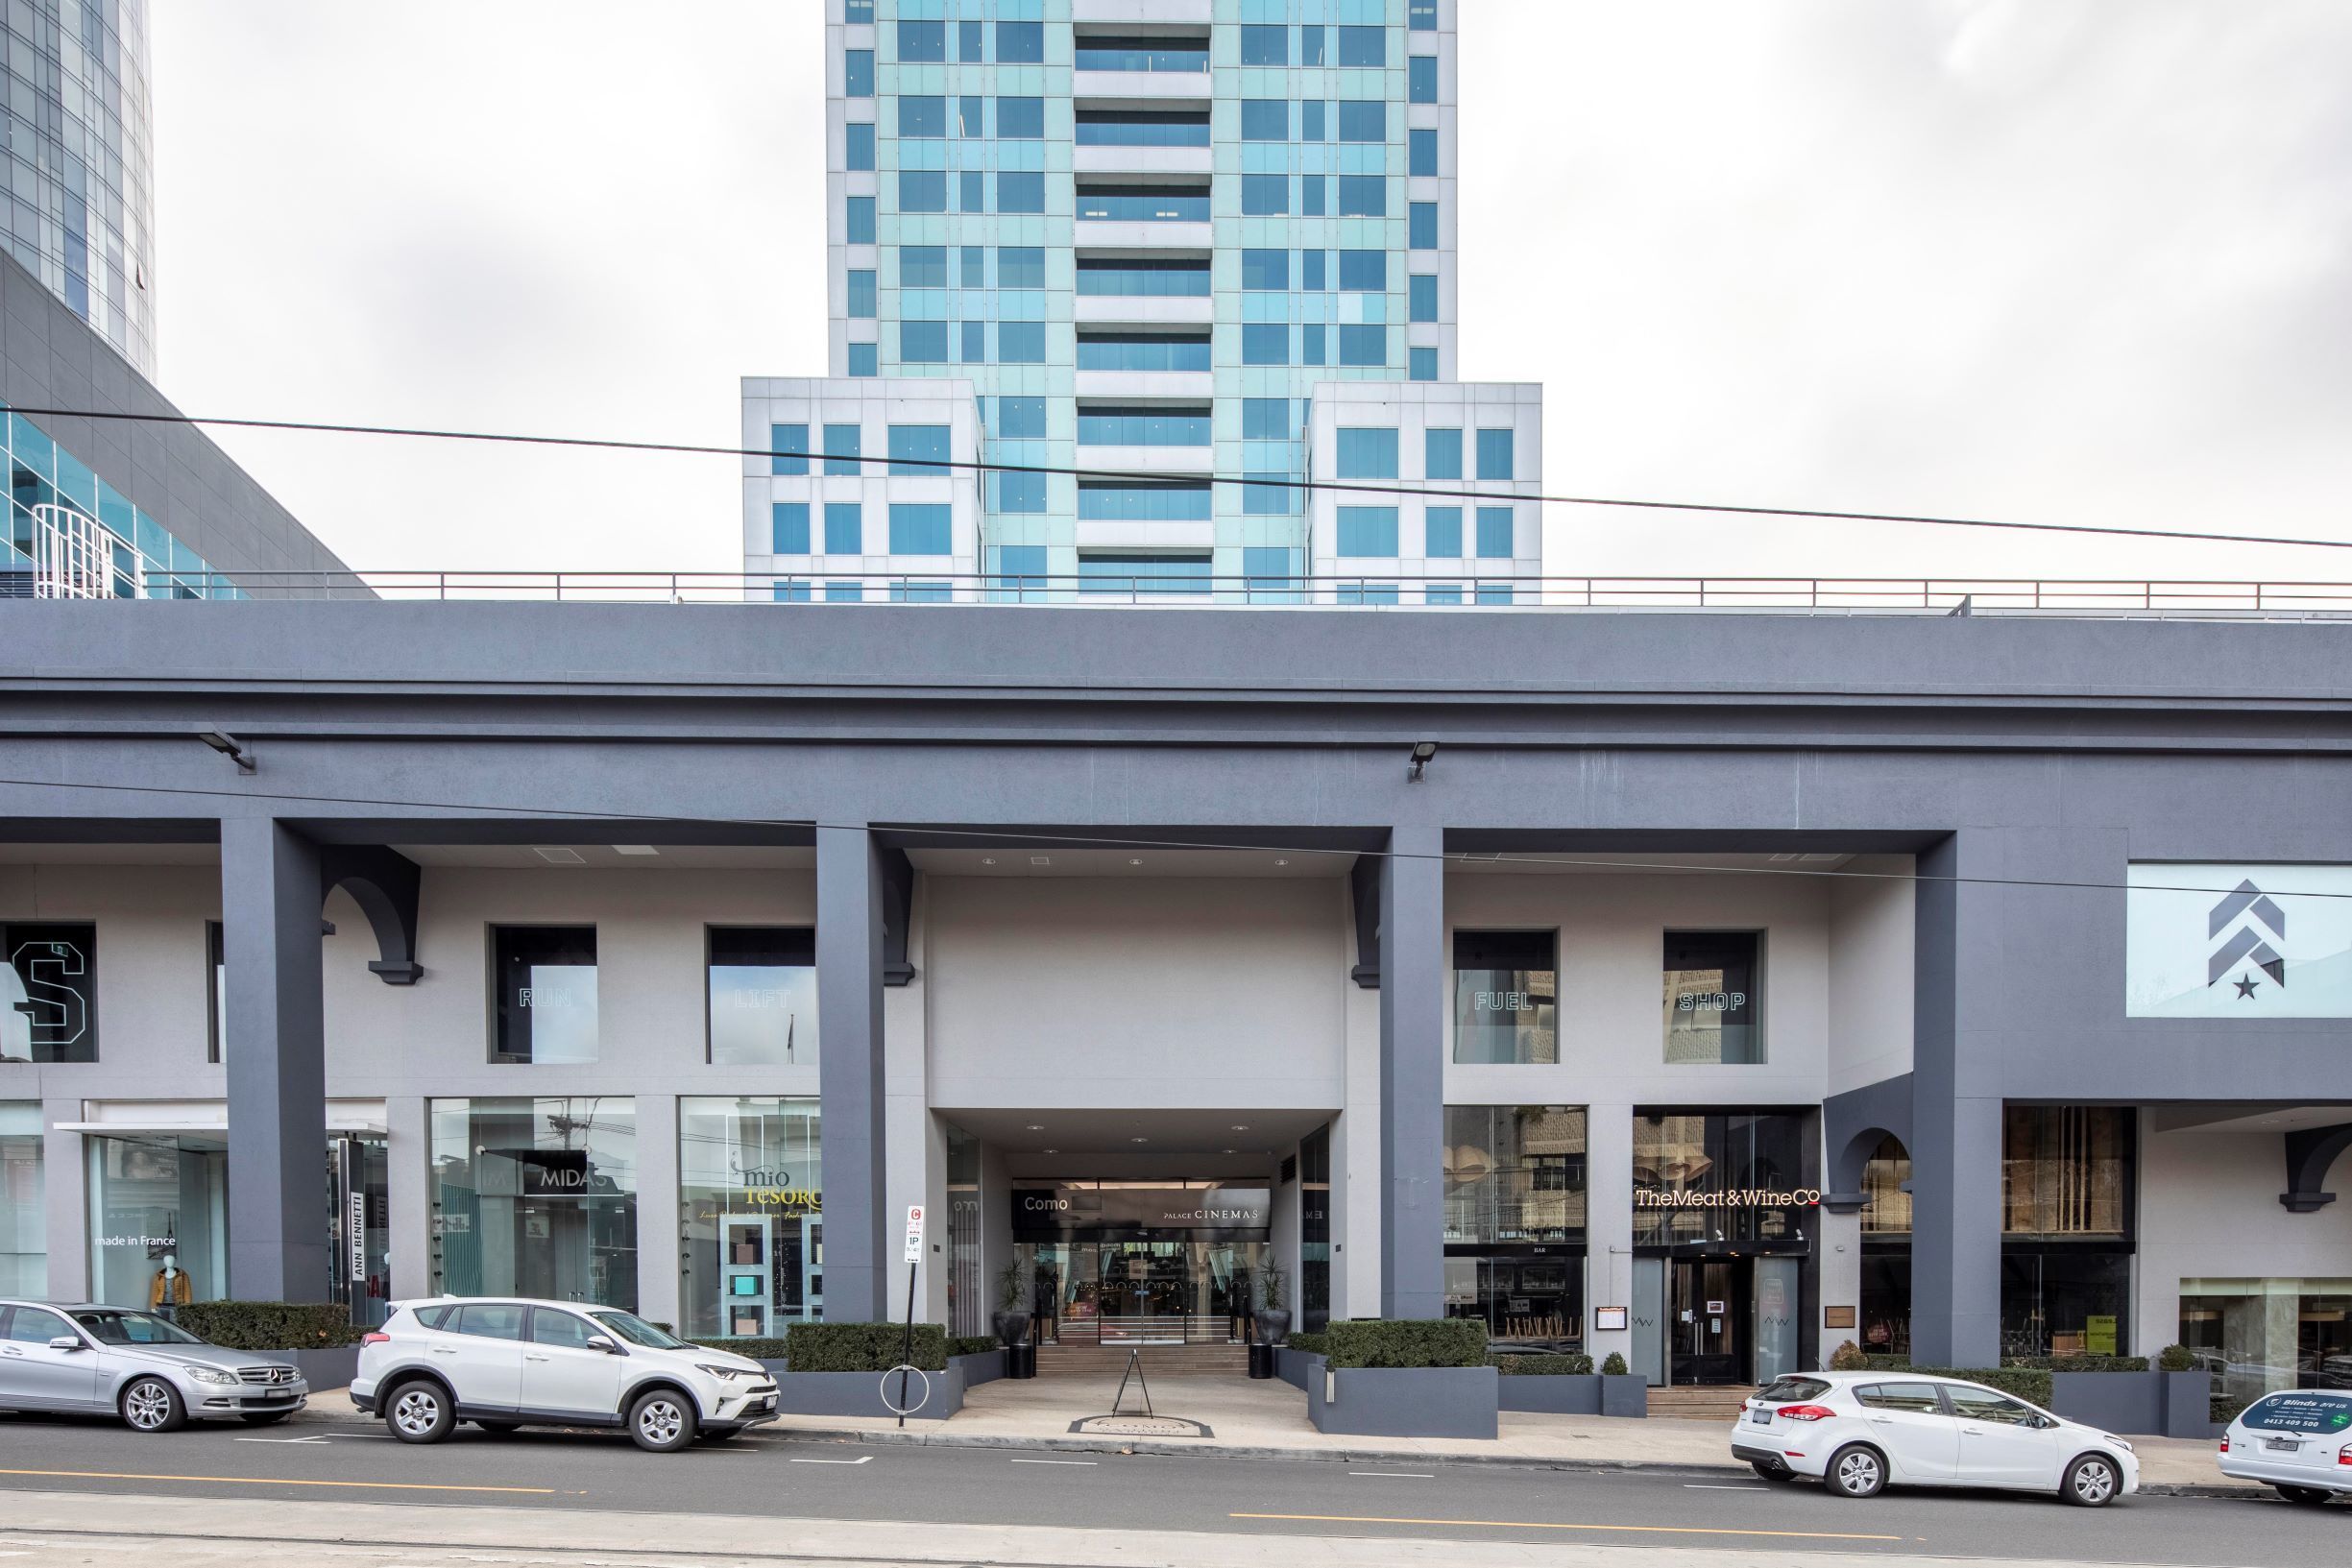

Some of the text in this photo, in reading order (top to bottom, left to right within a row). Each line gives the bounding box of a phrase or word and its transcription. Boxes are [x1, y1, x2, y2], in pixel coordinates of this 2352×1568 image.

[520, 988, 572, 1006] RUN
[1474, 992, 1533, 1010] FUEL
[1679, 992, 1746, 1011] SHOP
[540, 1169, 608, 1188] MIDAS
[743, 1170, 790, 1187] mio
[1024, 1196, 1068, 1210] Como
[352, 1195, 363, 1247] BENNETTI
[1194, 1210, 1259, 1219] CINEMAS
[94, 1235, 176, 1245] made in France
[353, 1252, 363, 1276] ANN
